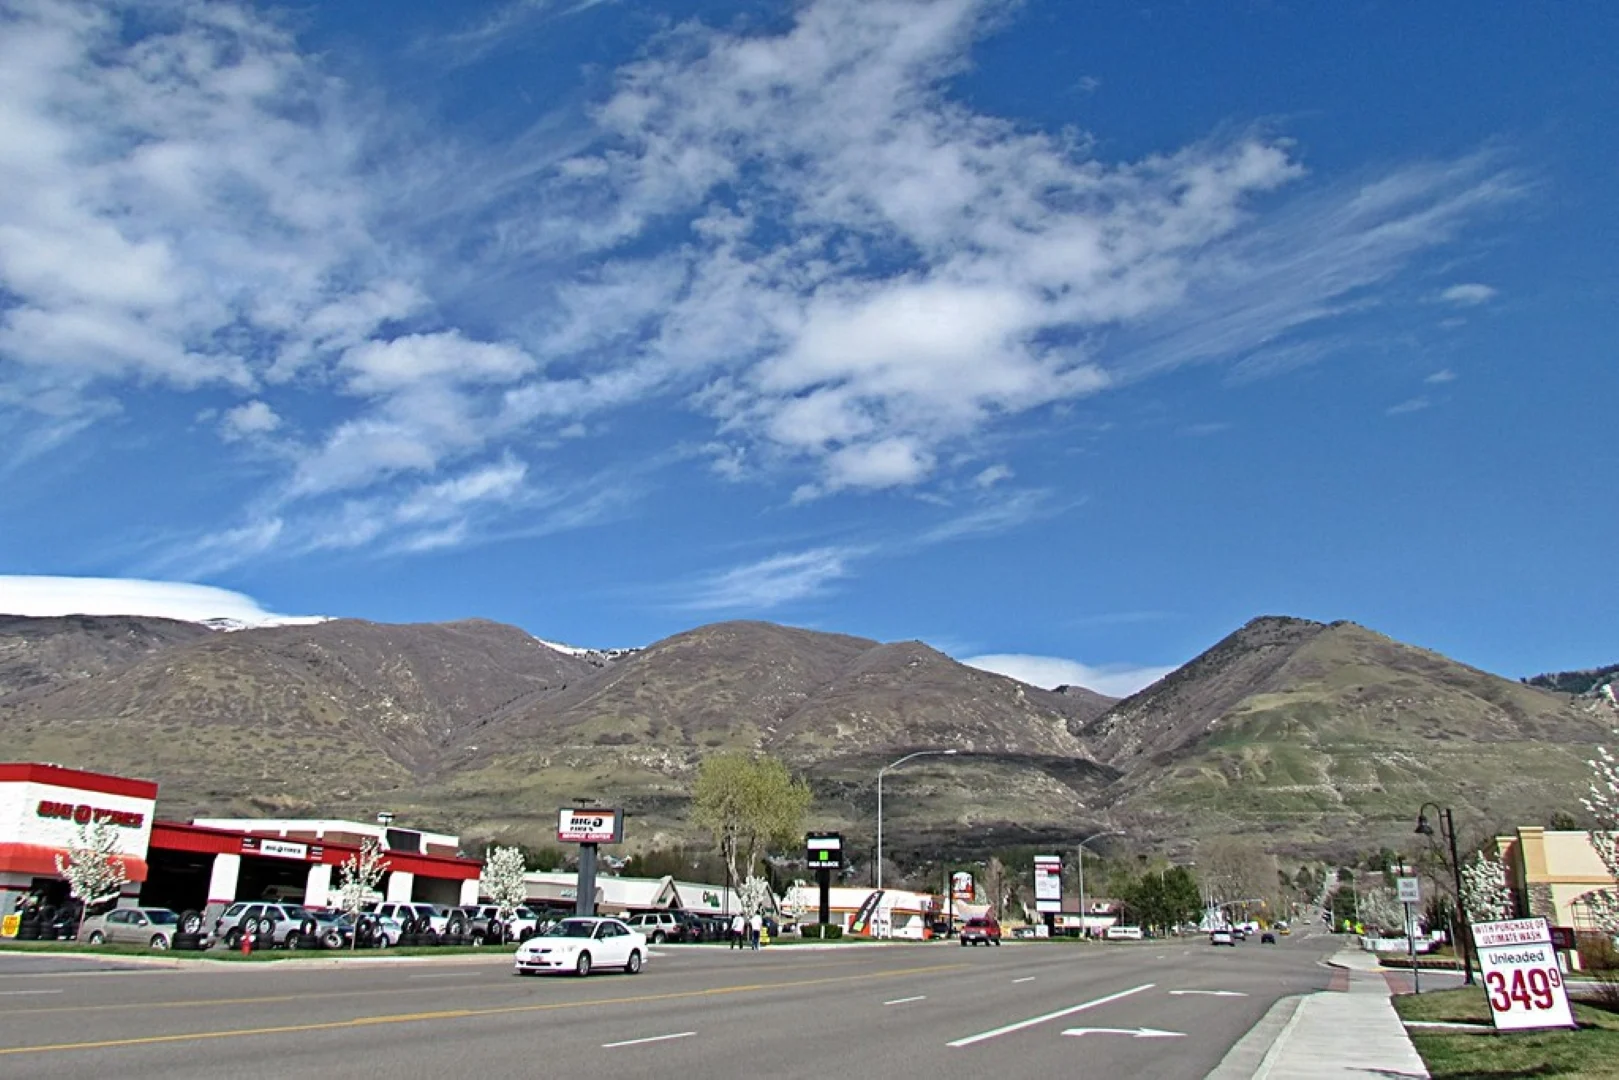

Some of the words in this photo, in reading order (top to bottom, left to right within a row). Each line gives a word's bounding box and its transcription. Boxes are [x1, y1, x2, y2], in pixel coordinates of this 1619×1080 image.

[570, 818, 591, 826] BIG
[592, 817, 603, 827] O
[1474, 924, 1494, 934] WITH
[1494, 920, 1534, 932] PURCHASE
[1534, 919, 1544, 928] OF
[1482, 933, 1518, 944] ULTIMATE
[1519, 931, 1542, 941] WASH
[1488, 950, 1545, 965] Unleaded
